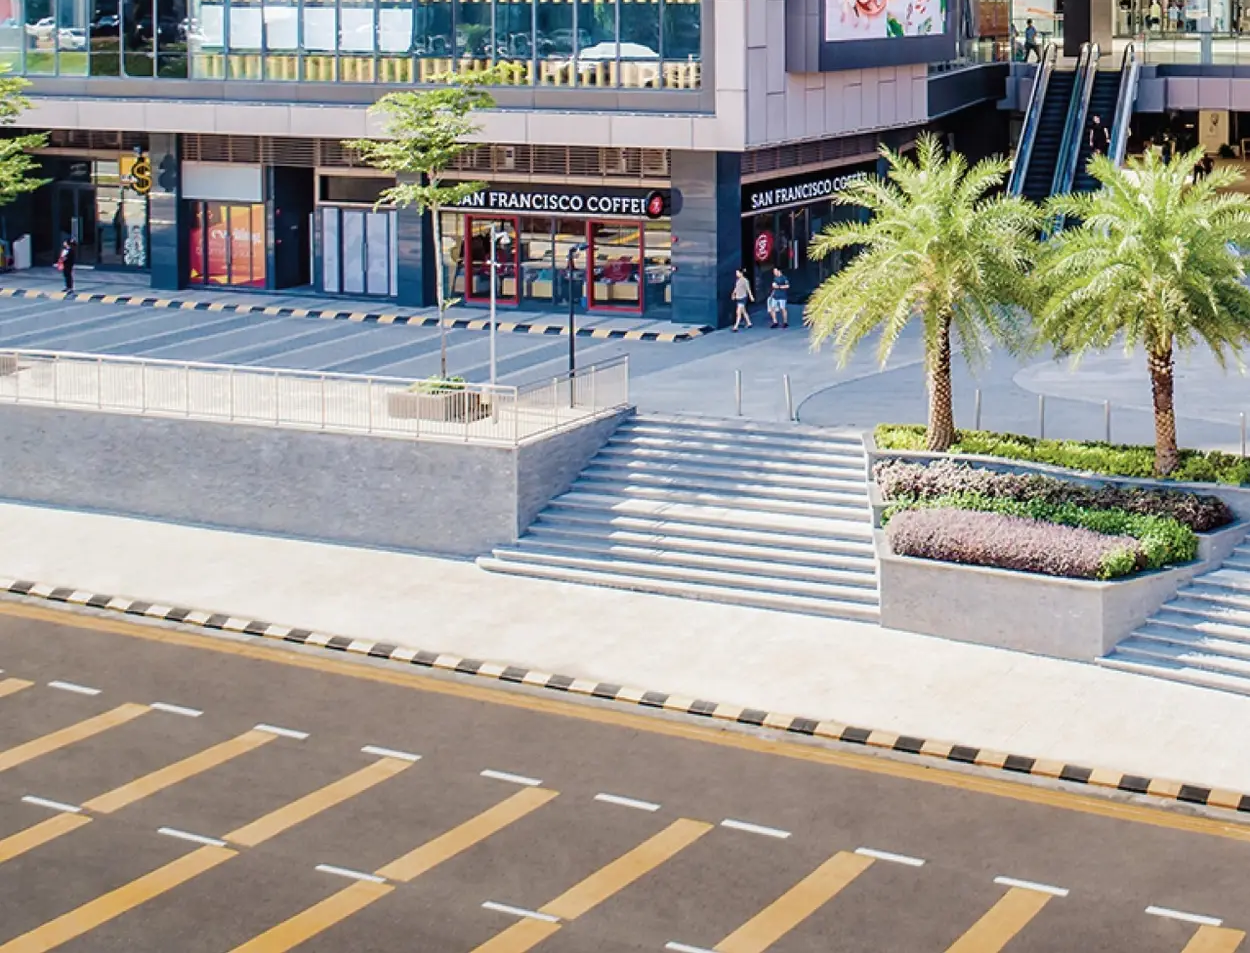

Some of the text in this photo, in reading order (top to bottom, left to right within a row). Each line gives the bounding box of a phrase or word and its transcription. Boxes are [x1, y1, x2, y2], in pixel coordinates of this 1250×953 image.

[457, 192, 484, 206] AN
[489, 192, 583, 210] FRANCISCO
[752, 190, 773, 209] SAN
[775, 179, 832, 203] FRANCISCO
